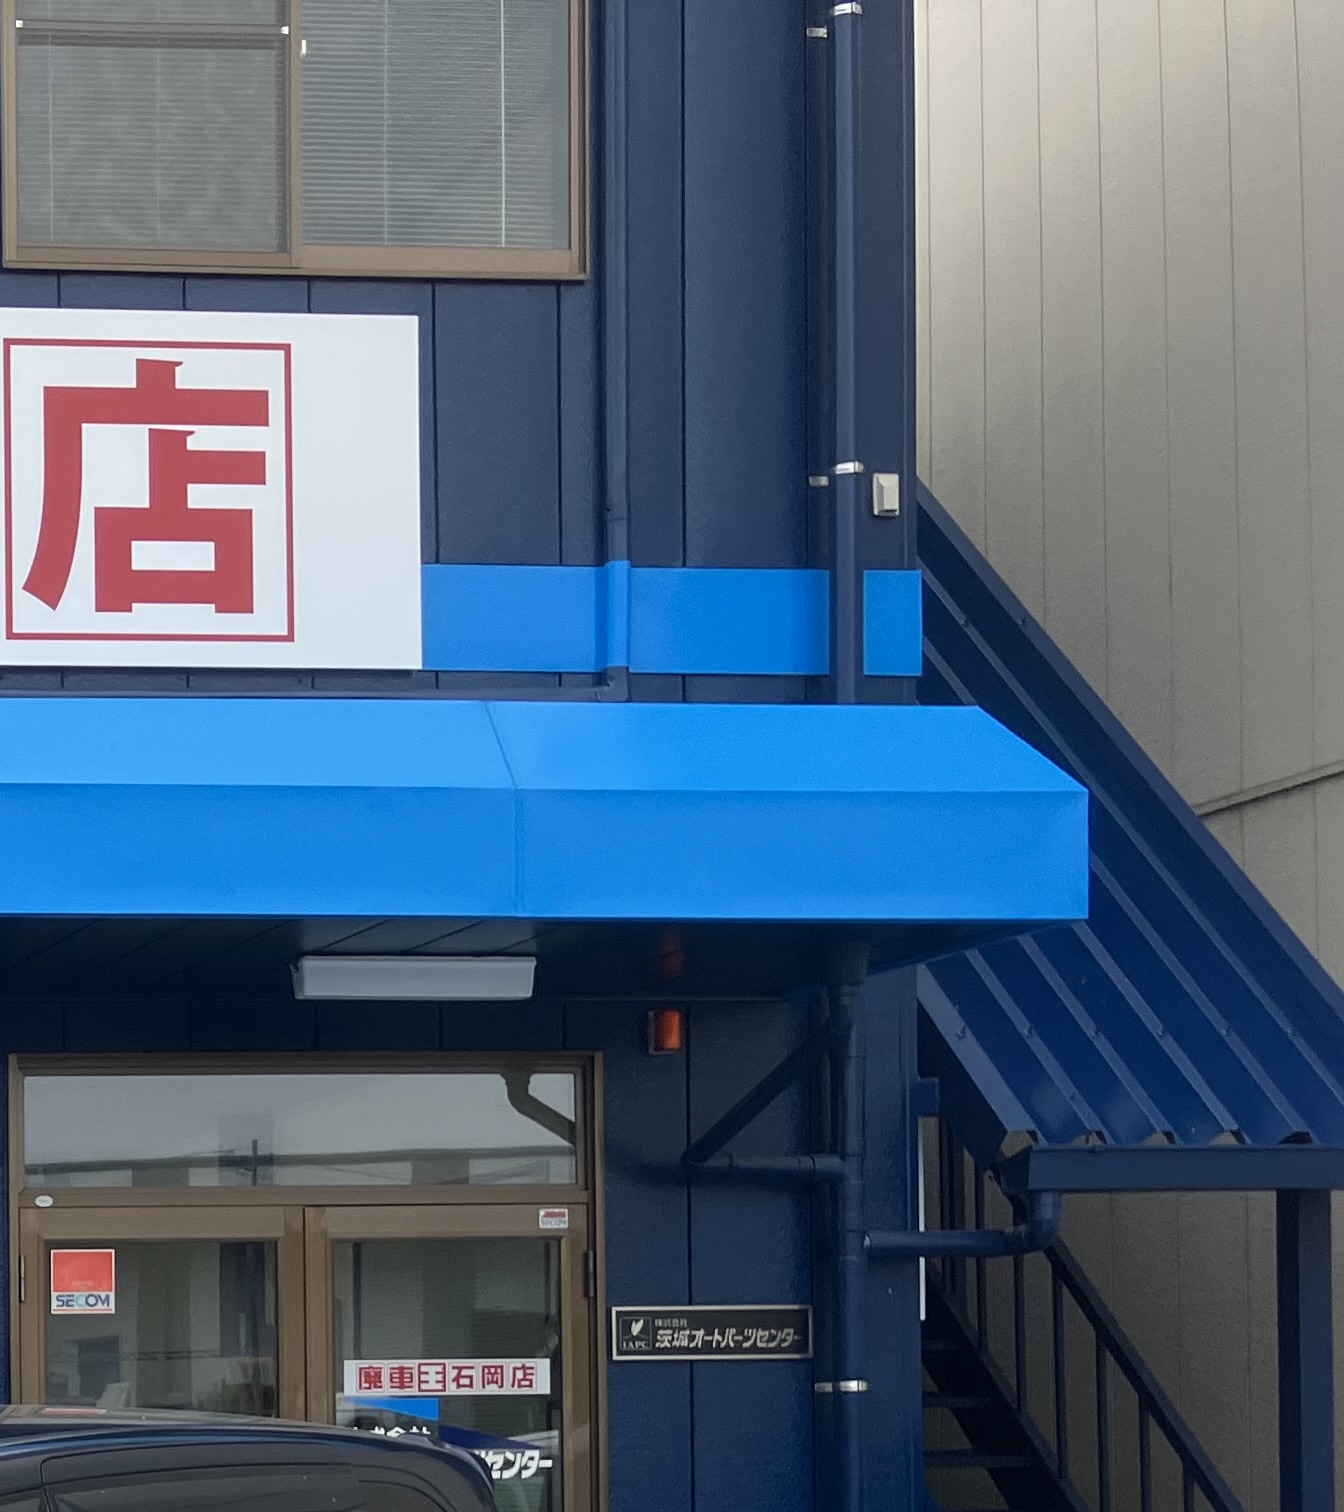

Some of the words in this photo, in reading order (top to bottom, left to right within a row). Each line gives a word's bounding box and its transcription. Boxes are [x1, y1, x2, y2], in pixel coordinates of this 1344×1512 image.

[55, 1293, 110, 1308] SECOM
[655, 1327, 803, 1349] 茨城オートパーツセンター
[474, 1449, 554, 1480] センター
